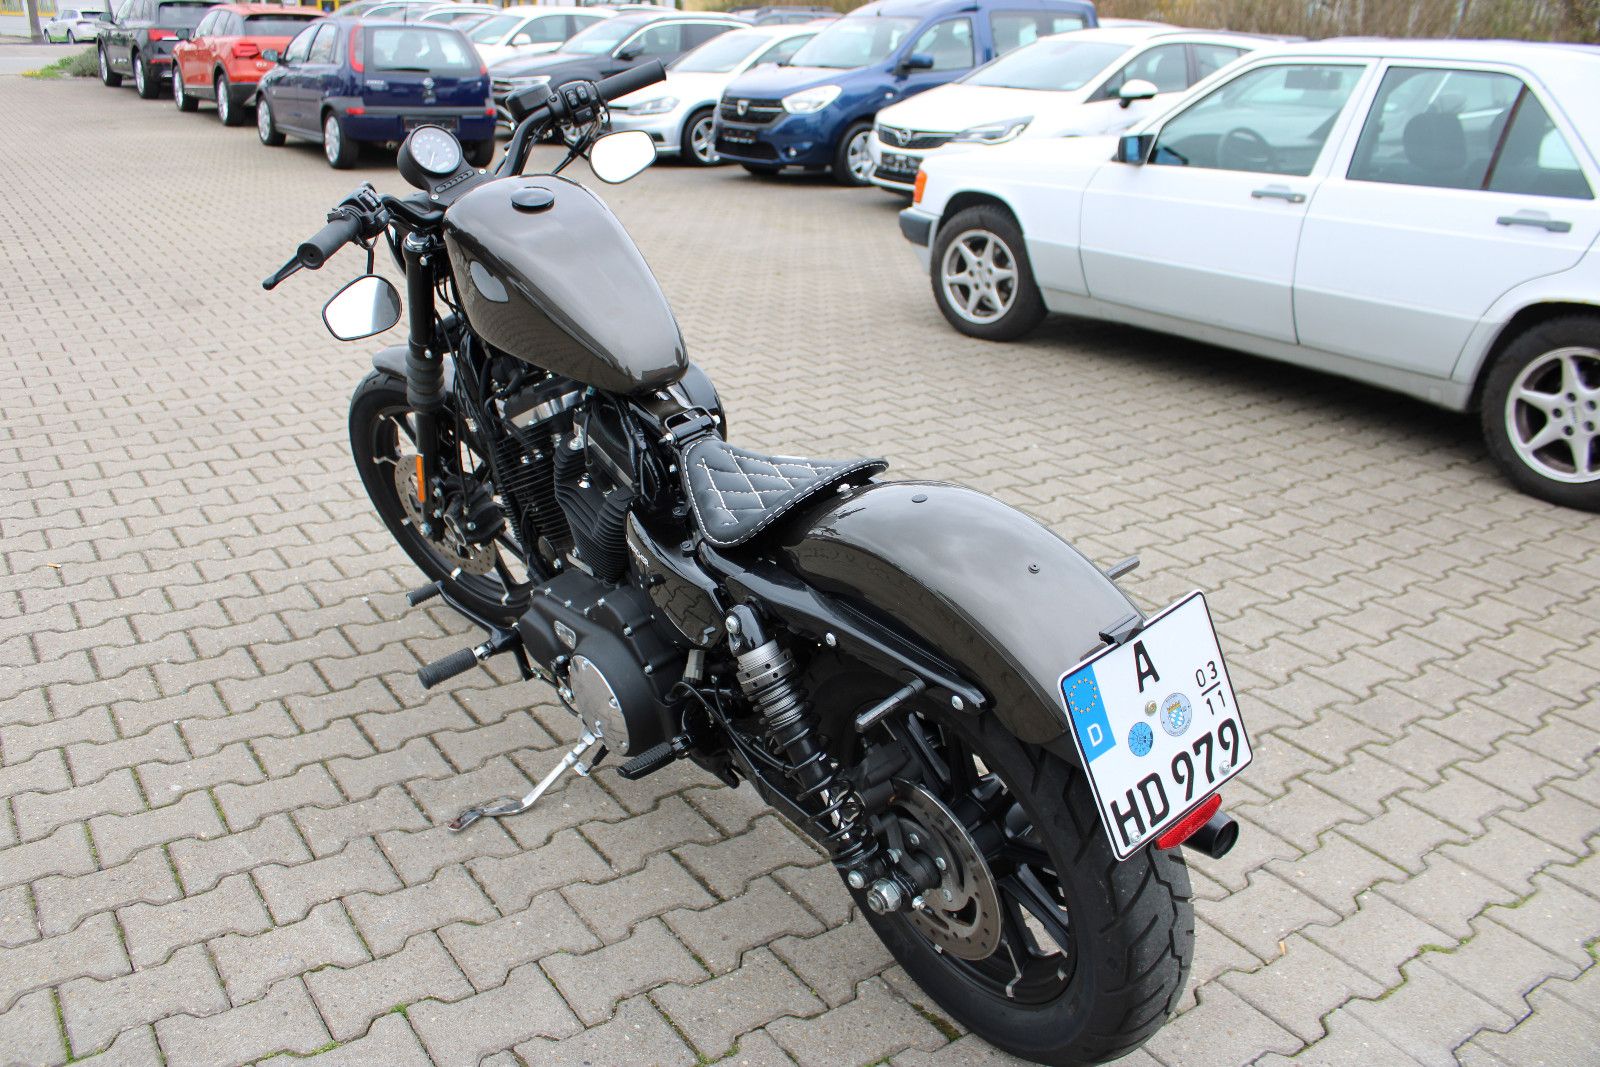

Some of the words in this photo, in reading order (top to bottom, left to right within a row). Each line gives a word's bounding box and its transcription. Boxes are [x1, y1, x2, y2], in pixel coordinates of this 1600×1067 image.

[1133, 640, 1160, 693] A
[1195, 660, 1218, 688] 03
[1206, 689, 1226, 716] 11
[1087, 723, 1103, 748] D
[1110, 772, 1170, 848] HD
[1171, 718, 1239, 802] 979
